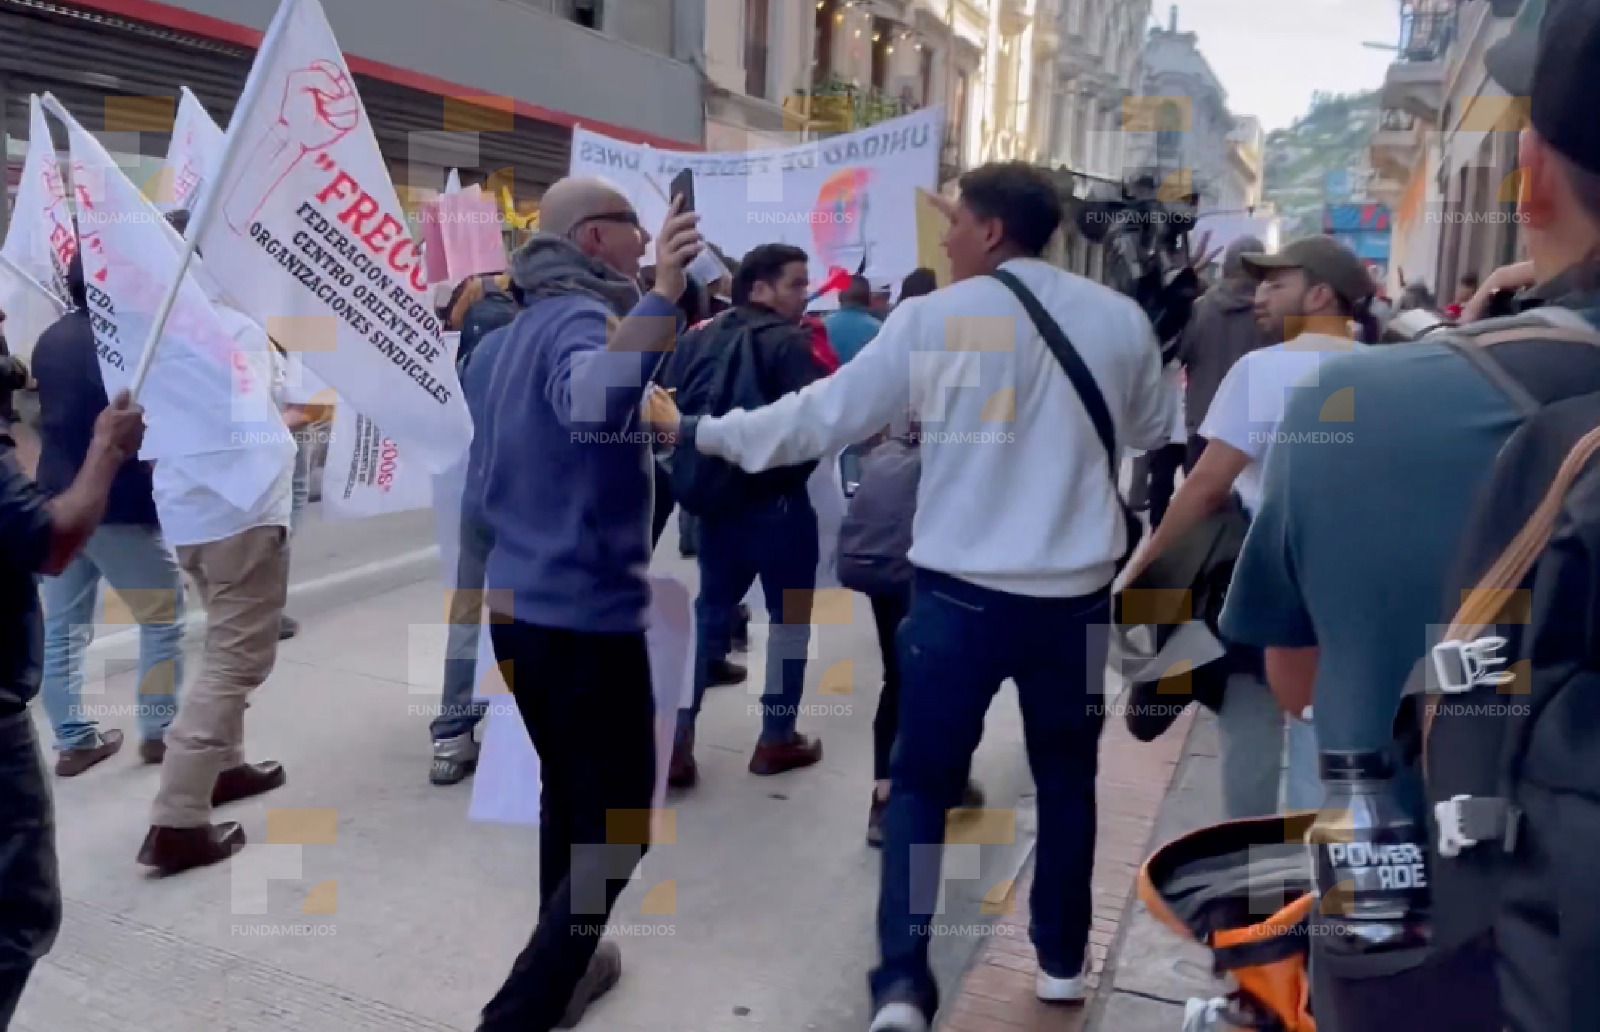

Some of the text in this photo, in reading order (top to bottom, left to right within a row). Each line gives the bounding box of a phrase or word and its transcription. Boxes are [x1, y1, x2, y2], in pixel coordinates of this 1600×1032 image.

[292, 230, 440, 363] CENTRO ORIENTE DE
[296, 200, 393, 290] FEDERACION
[250, 222, 452, 404] ORGANIZACIONES SINDICALES
[1326, 841, 1425, 868] POWER
